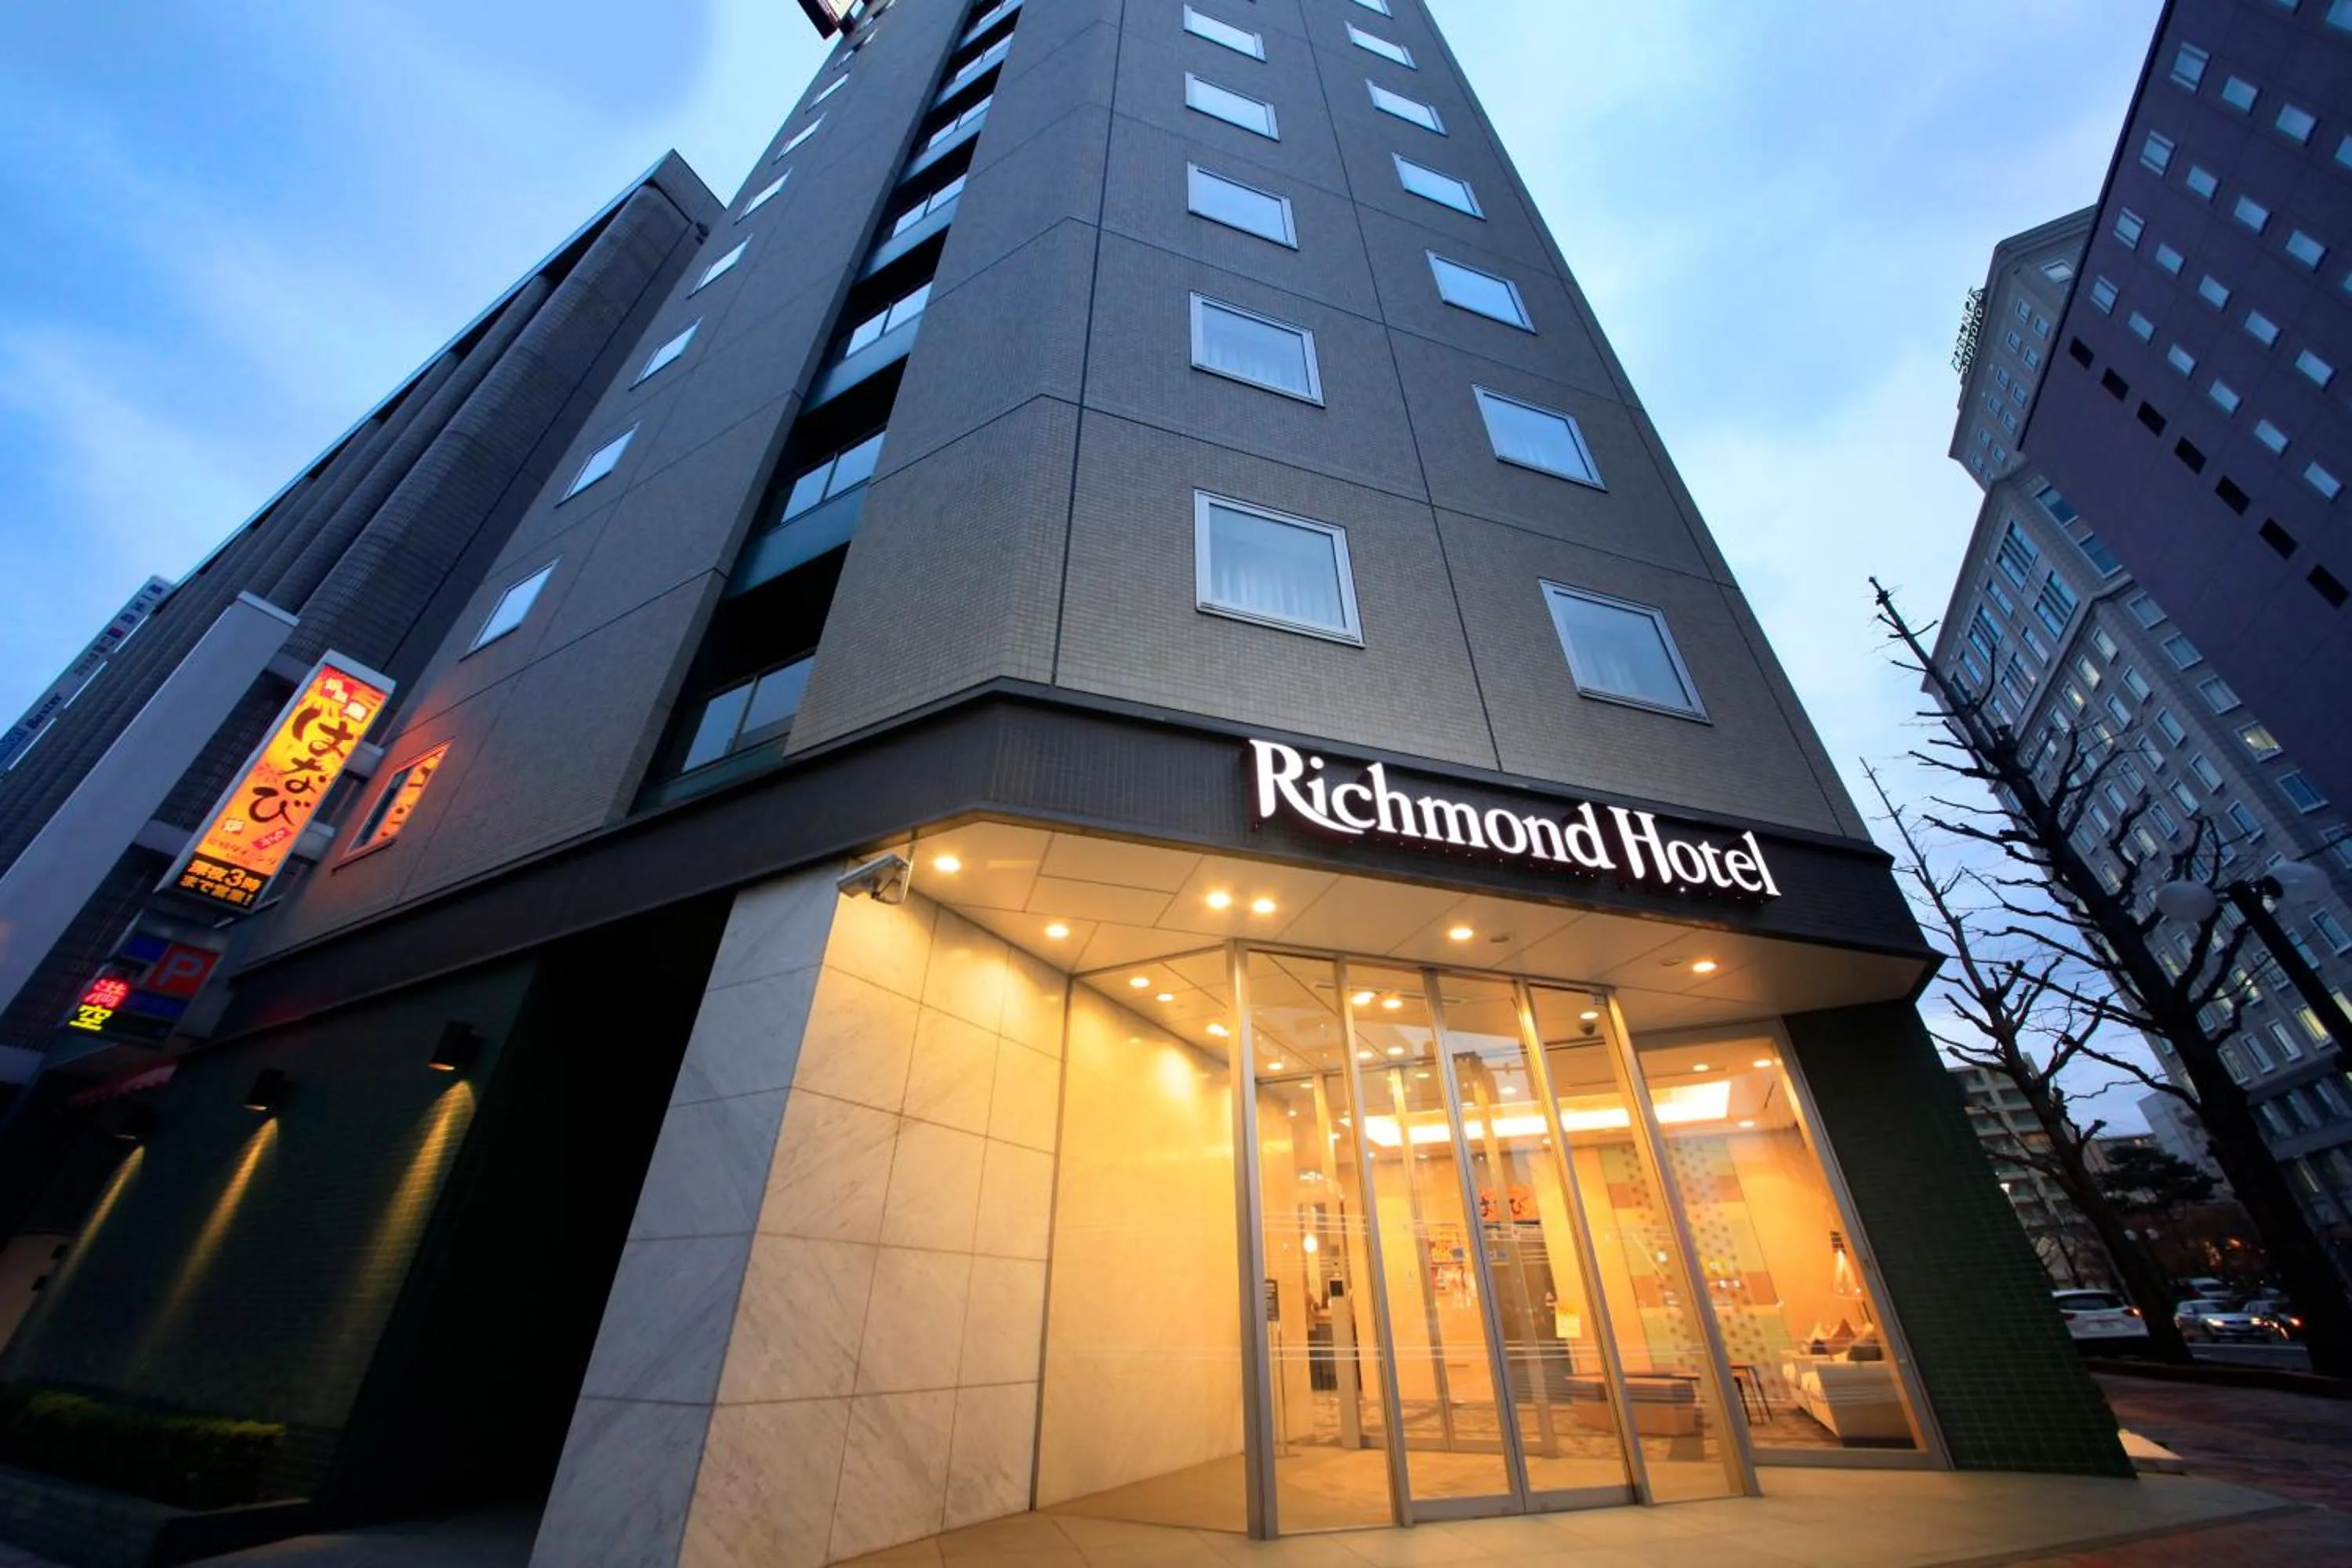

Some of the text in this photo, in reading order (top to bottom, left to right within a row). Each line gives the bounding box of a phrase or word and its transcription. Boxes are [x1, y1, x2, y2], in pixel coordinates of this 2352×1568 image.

[1960, 307, 1984, 374] Sapporo
[247, 706, 354, 826] はなび
[1247, 738, 1782, 898] Richmond Hotel
[159, 953, 205, 985] P
[68, 1004, 114, 1031] 空
